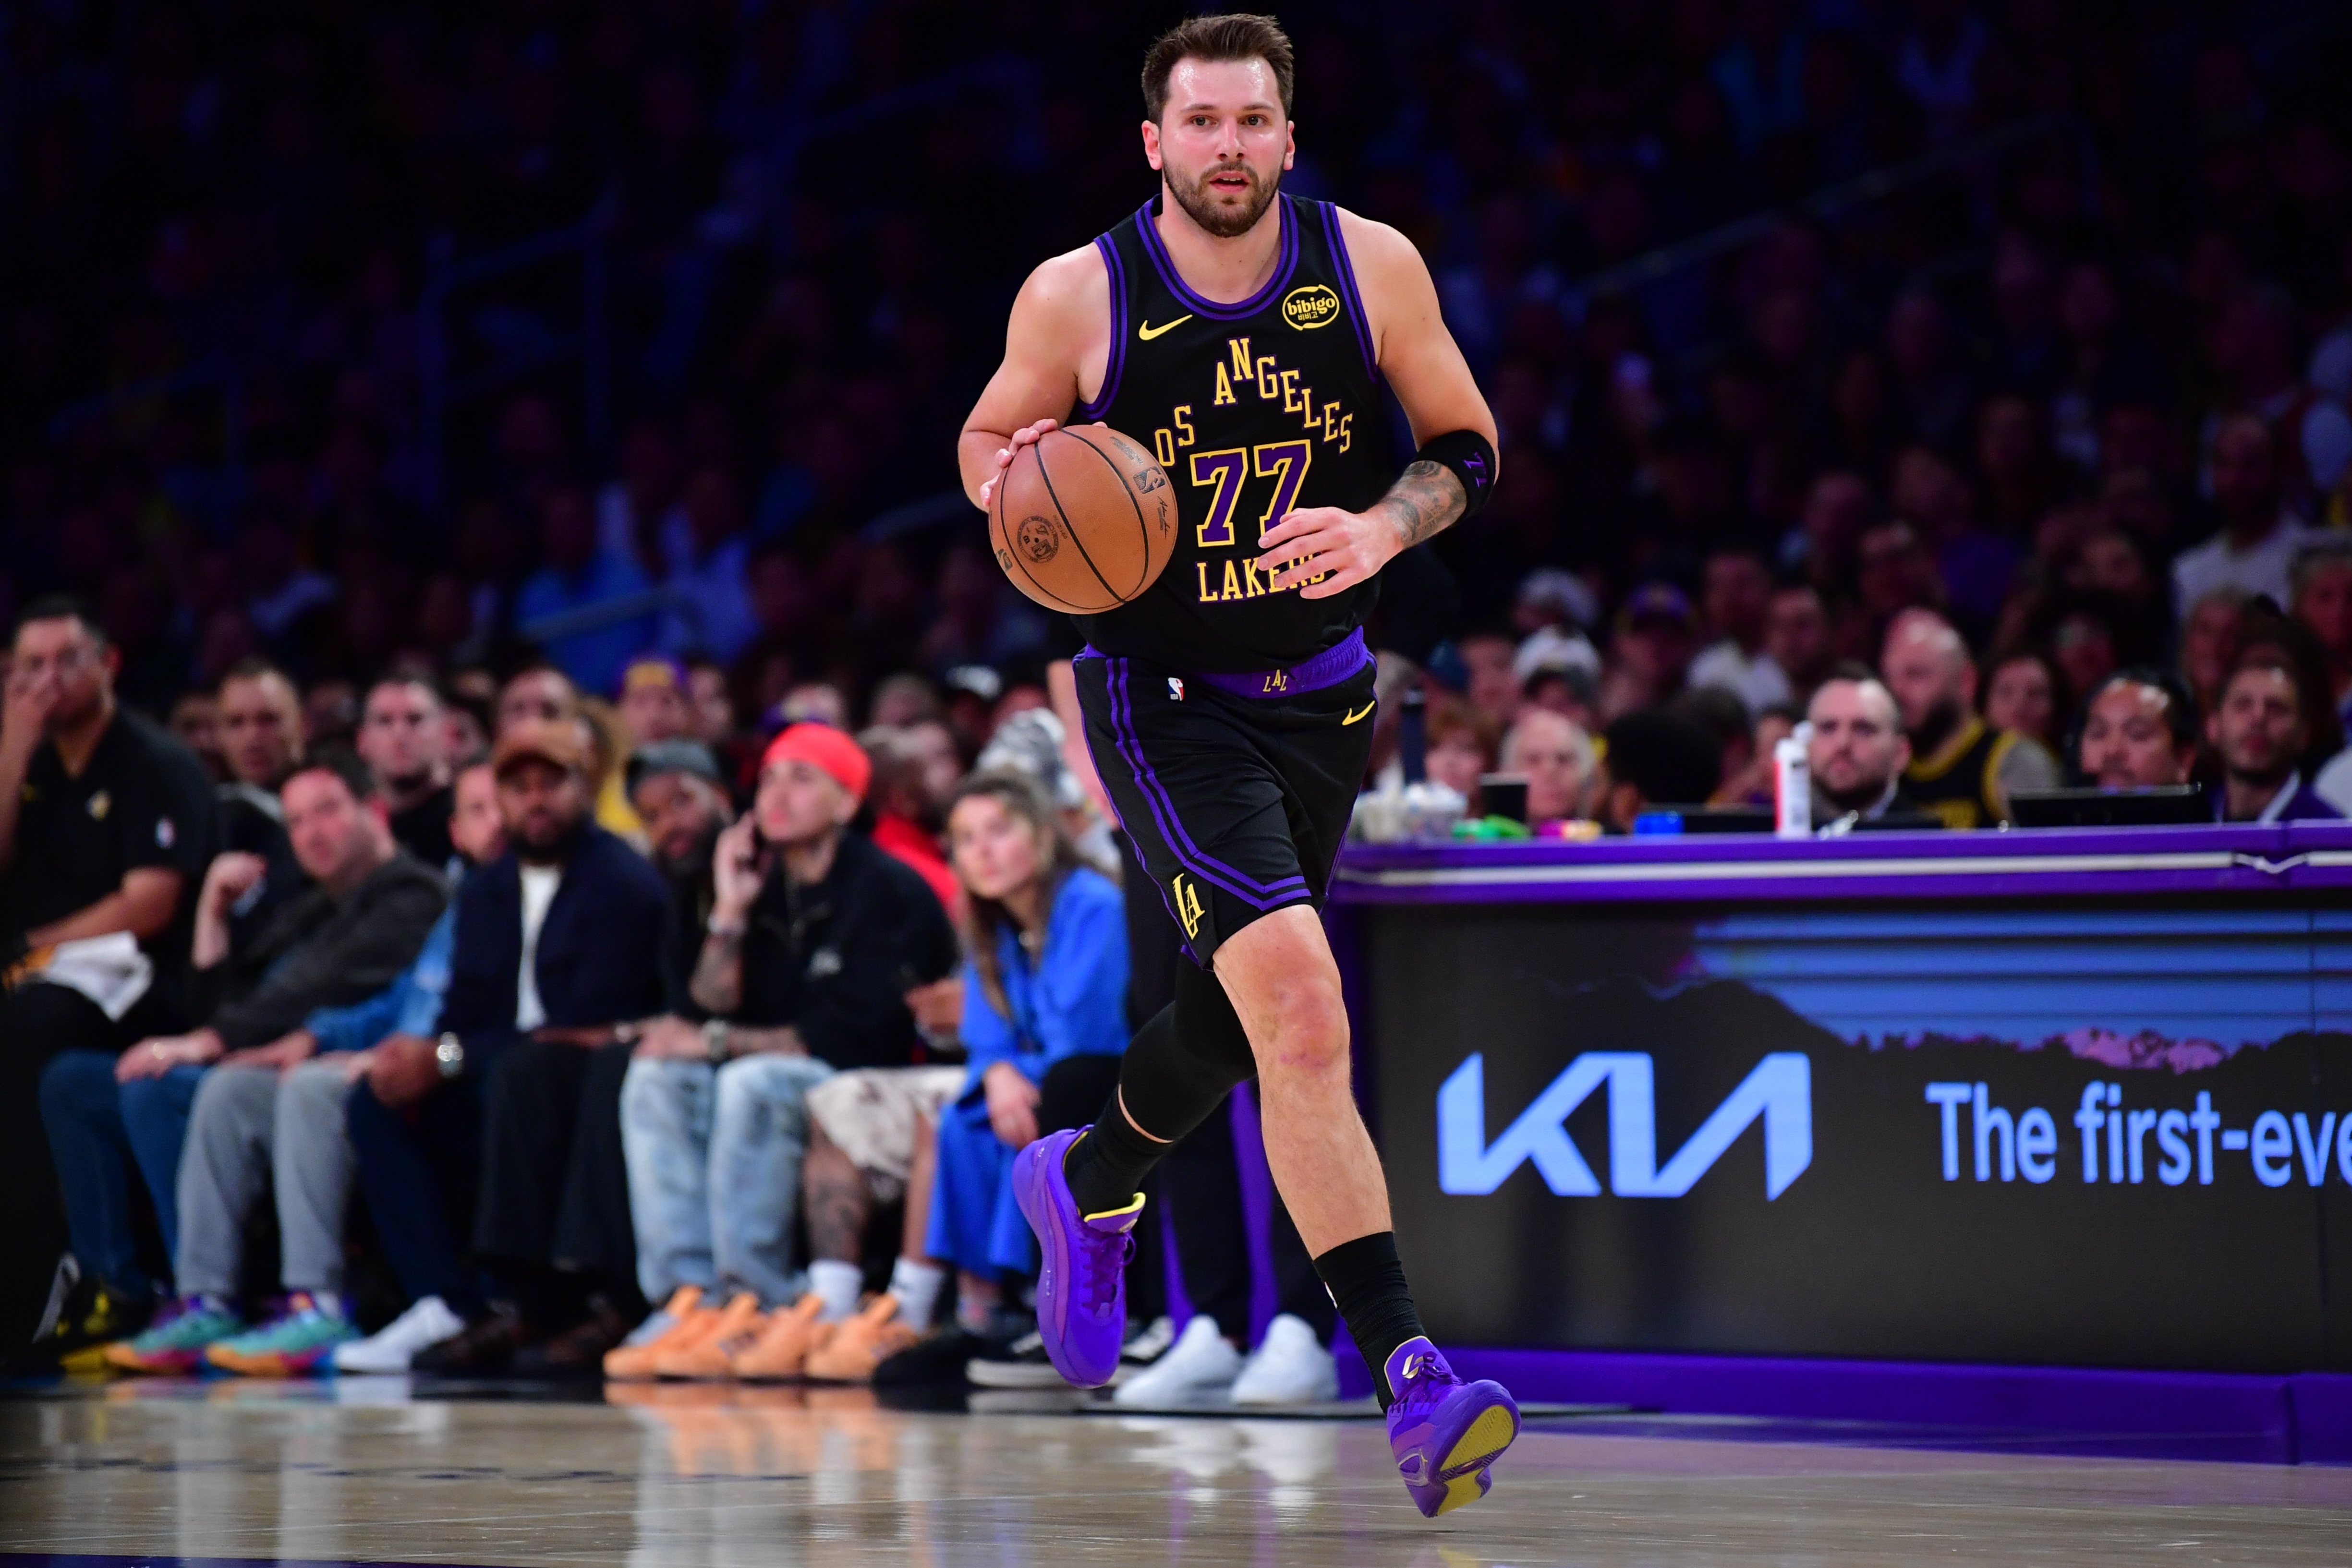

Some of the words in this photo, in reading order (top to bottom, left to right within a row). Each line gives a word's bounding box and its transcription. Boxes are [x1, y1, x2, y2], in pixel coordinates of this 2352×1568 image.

[1286, 297, 1336, 315] bibigo
[1297, 311, 1319, 321] 비비고
[1154, 404, 1195, 467] OS
[1213, 337, 1353, 454] ANGELES
[1189, 434, 1312, 547] 77
[1197, 552, 1325, 602] LAKE
[1262, 669, 1287, 692] LAL
[1173, 873, 1205, 940] LA
[1925, 1081, 2058, 1184] The
